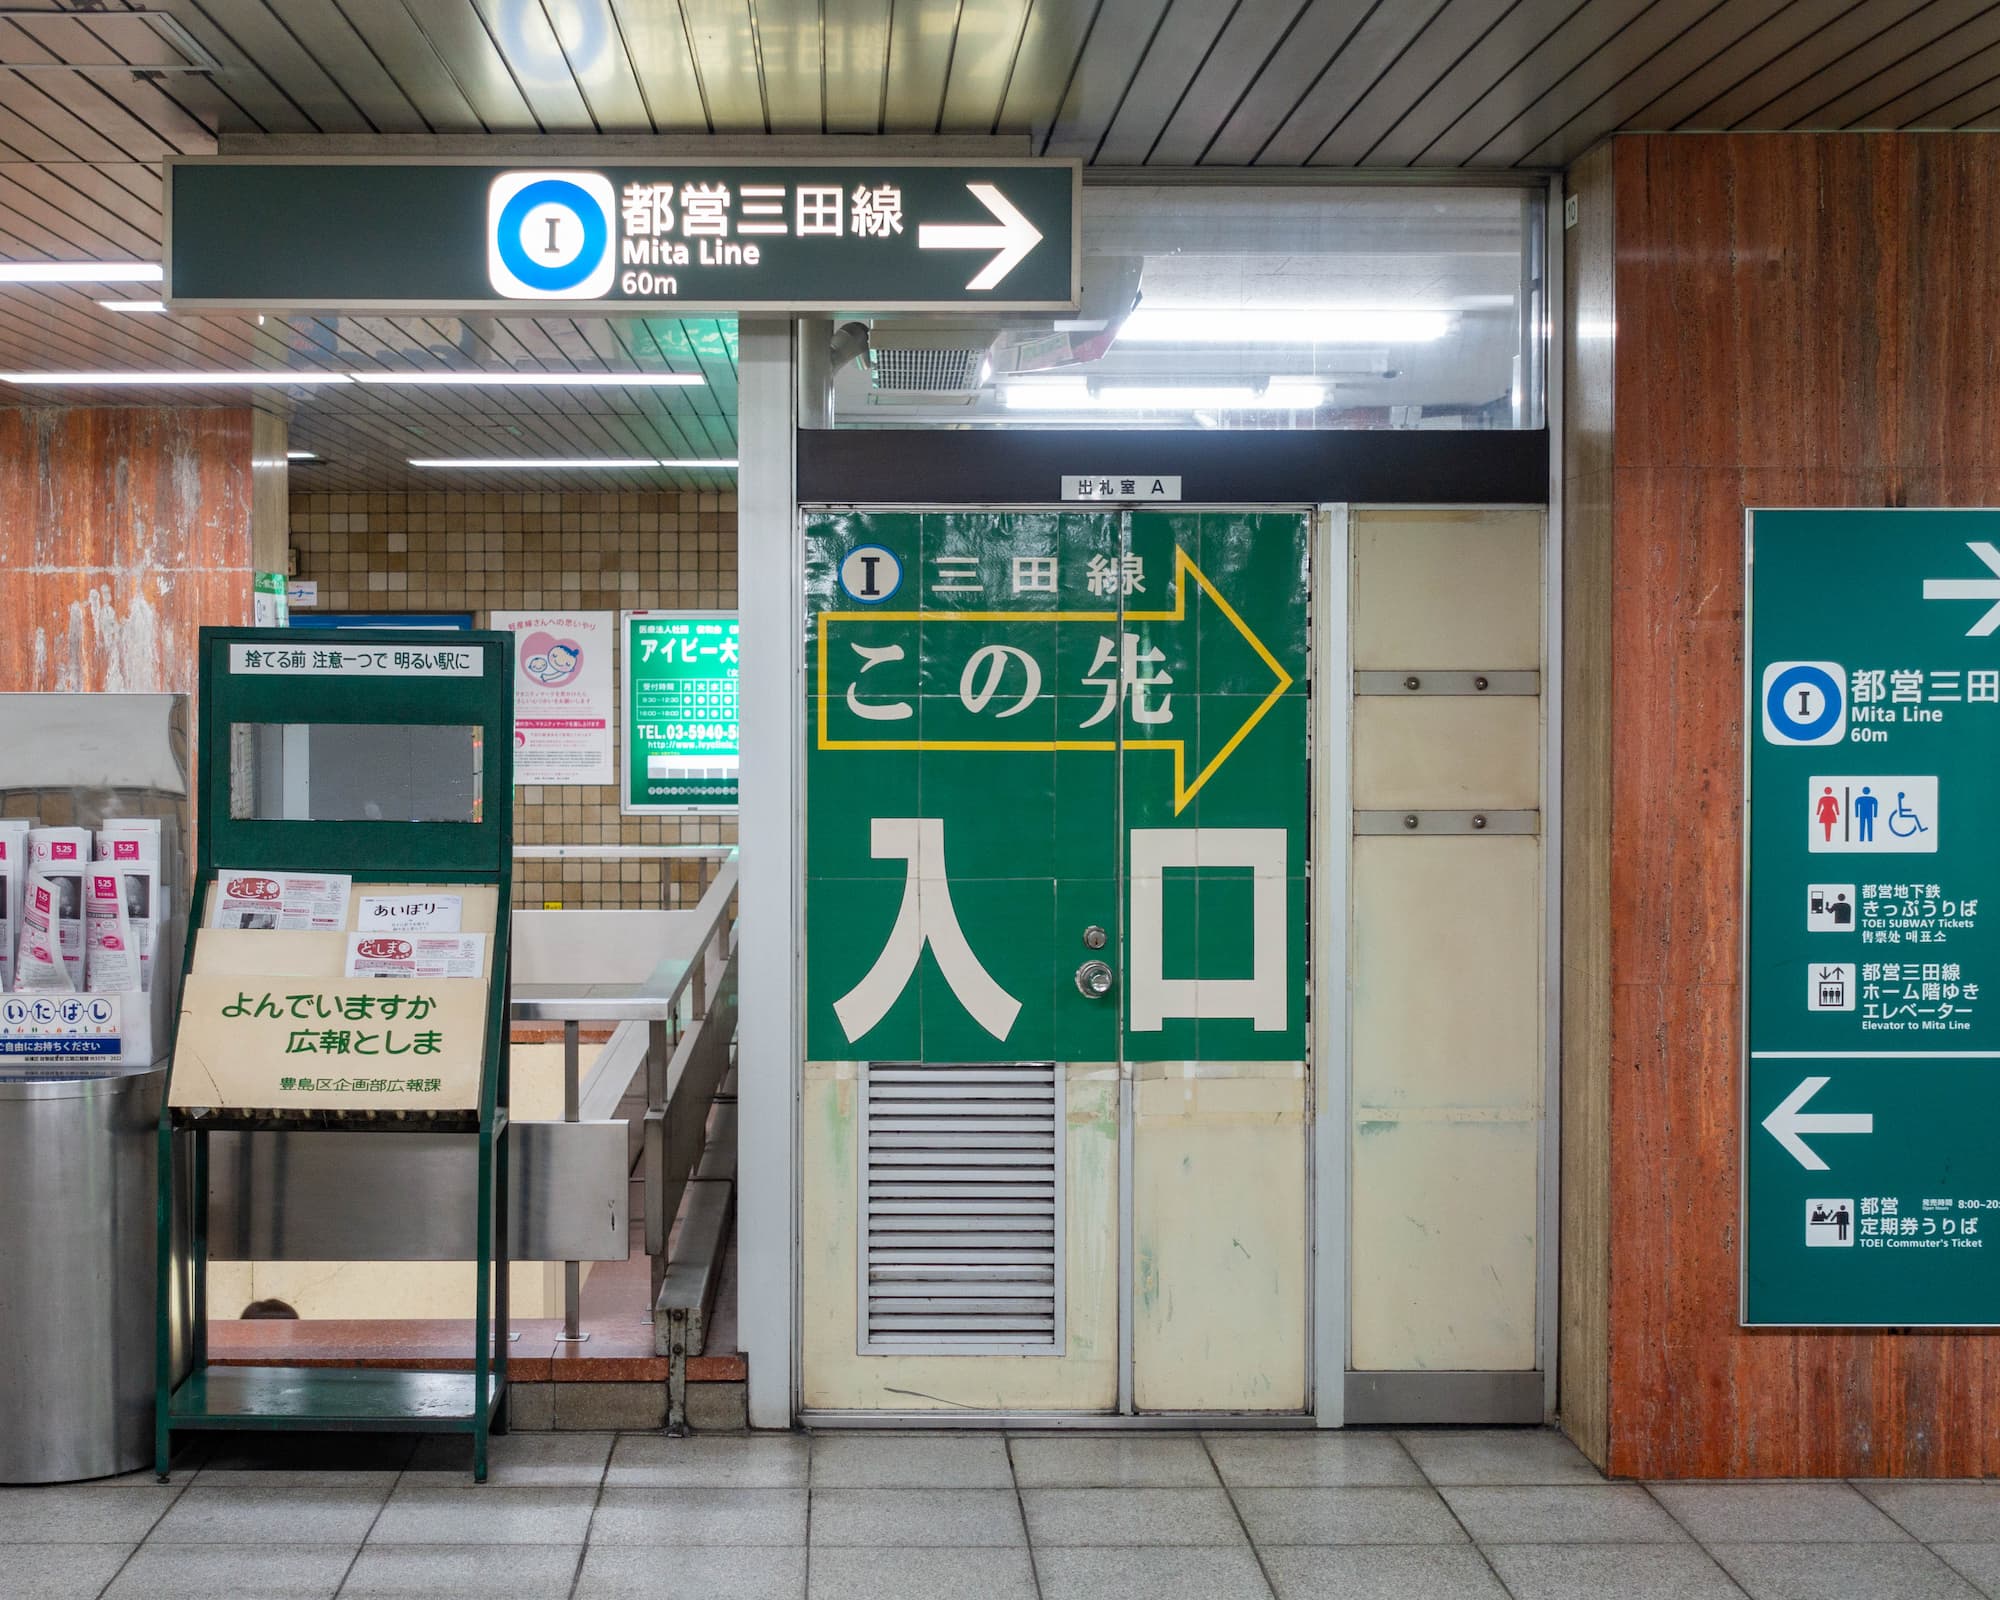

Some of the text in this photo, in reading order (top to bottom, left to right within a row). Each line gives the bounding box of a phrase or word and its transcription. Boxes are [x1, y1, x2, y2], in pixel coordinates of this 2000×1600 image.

[621, 183, 904, 238] 都営三田線
[544, 218, 561, 254] I
[622, 240, 760, 266] Mita Line
[622, 273, 677, 295] 60m
[1078, 479, 1165, 496] 出札室 A
[860, 557, 881, 596] I
[931, 553, 1147, 596] 三田線
[245, 650, 470, 671] 捨てる前 注意一つで 明るい駅に
[846, 632, 1174, 729] この先
[1850, 669, 2000, 704] 都営三田
[1798, 691, 1810, 716] I
[1851, 706, 1943, 723] Mita Line
[1851, 727, 1888, 742] 60m
[1862, 884, 1941, 899] 都営地下鉄
[1862, 900, 1979, 918] きっぷうりば
[832, 817, 1288, 1045] 入口
[1862, 919, 1975, 928] TOEI SUBWAY Tickets
[1905, 930, 1947, 944] 매표소
[1862, 963, 1961, 982] 都営三田線
[1862, 983, 1980, 1001] ホーム階ゆき
[221, 992, 437, 1021] よんでいますか
[1862, 1002, 1973, 1020] エレベーター
[1861, 1021, 1971, 1030] Elevator to Mita Line
[285, 1028, 443, 1056] 広報としま
[279, 1077, 441, 1093] 豊島区企画部広報課
[1860, 1197, 1899, 1216] 都営
[1860, 1216, 1979, 1236] 定期券うりば
[1860, 1238, 1983, 1248] TOEI Commuter's Ticket
